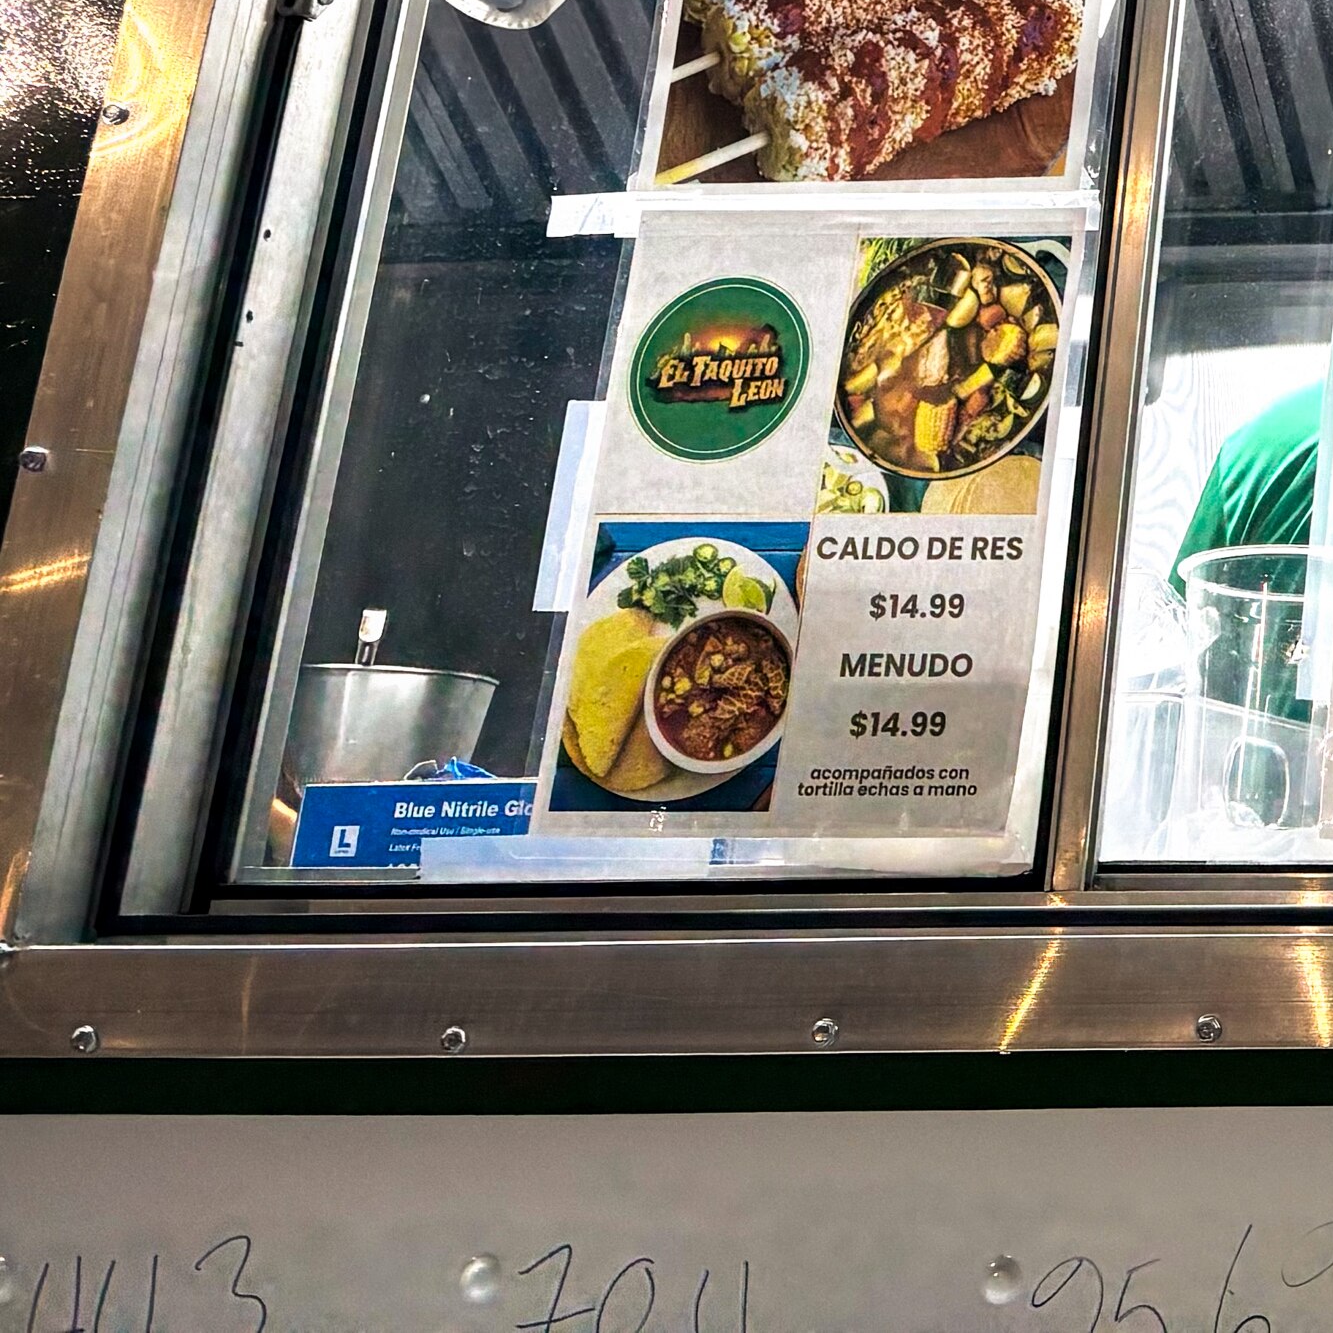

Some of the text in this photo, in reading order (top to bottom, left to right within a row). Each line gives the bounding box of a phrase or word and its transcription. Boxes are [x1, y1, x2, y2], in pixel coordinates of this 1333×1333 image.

[658, 354, 778, 387] EL TAQUITO
[730, 375, 785, 408] LEON
[817, 537, 1023, 560] CALDO DE RES
[869, 592, 964, 621] $14.99
[840, 653, 972, 677] MENUDO
[850, 710, 946, 739] $14.99
[811, 766, 969, 784] acompañados con
[798, 781, 977, 796] tortilla echas a mano
[394, 803, 434, 818] Blue
[441, 801, 498, 817] Nitrile
